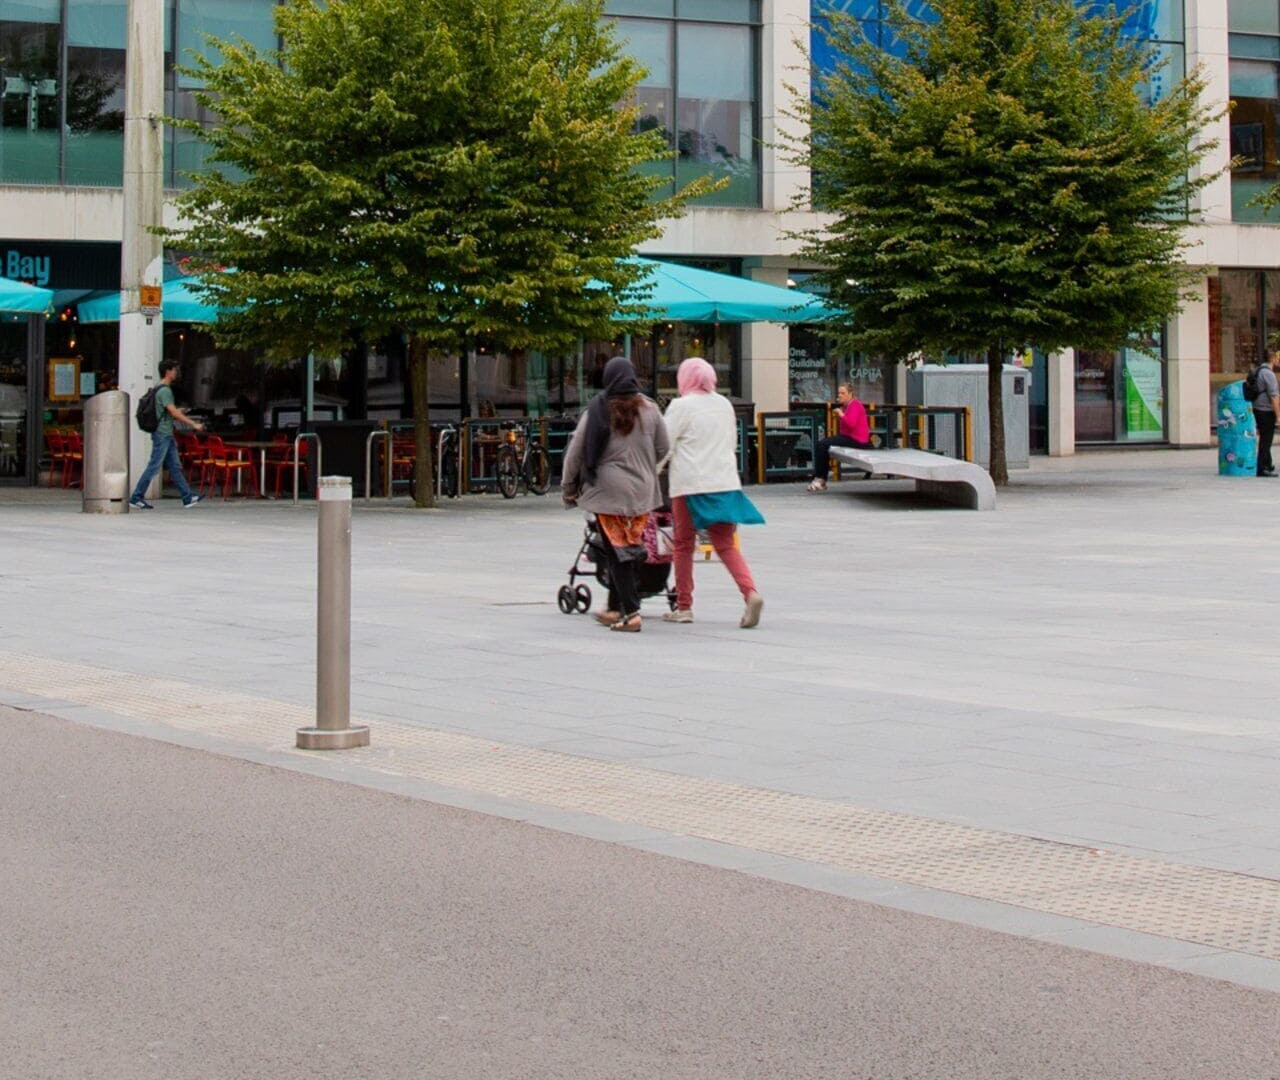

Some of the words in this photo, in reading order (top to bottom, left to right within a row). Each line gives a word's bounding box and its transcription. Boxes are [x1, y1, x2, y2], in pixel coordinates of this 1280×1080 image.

[8, 251, 50, 286] Bay
[790, 347, 807, 357] One
[790, 358, 826, 368] Guildhall
[790, 369, 819, 379] Square
[849, 367, 883, 379] CAPITA
